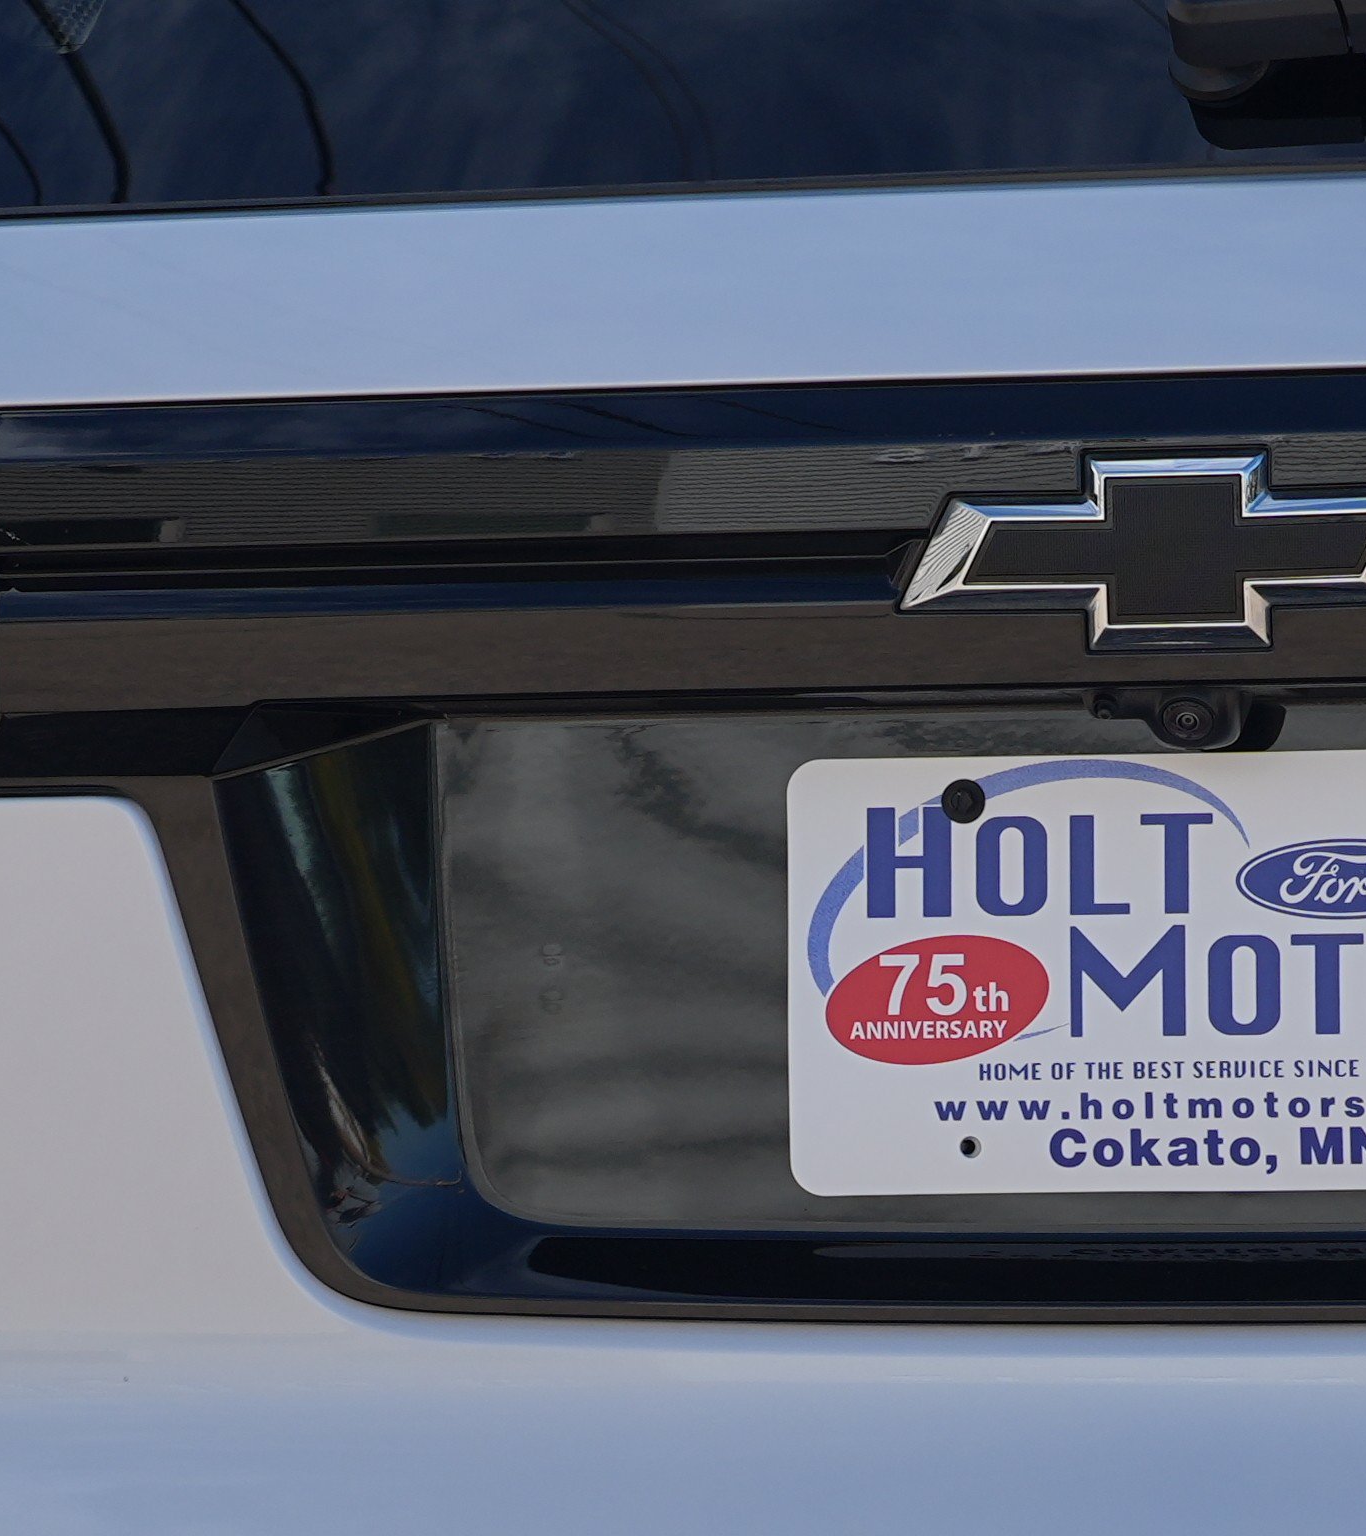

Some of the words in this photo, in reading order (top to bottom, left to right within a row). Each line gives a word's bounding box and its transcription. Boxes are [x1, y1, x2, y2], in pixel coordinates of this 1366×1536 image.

[865, 807, 1213, 919] HOLT
[878, 952, 1011, 1017] 75th
[849, 1018, 1009, 1041] ANNIVERSARY
[978, 1062, 1043, 1082] HOME
[1050, 1061, 1077, 1081] OF
[1084, 1061, 1125, 1080] THE
[1132, 1060, 1185, 1080] BEST
[1192, 1059, 1286, 1079] SERVICE
[1293, 1058, 1360, 1078] SINCE
[1048, 1127, 1279, 1175] Cokato,
